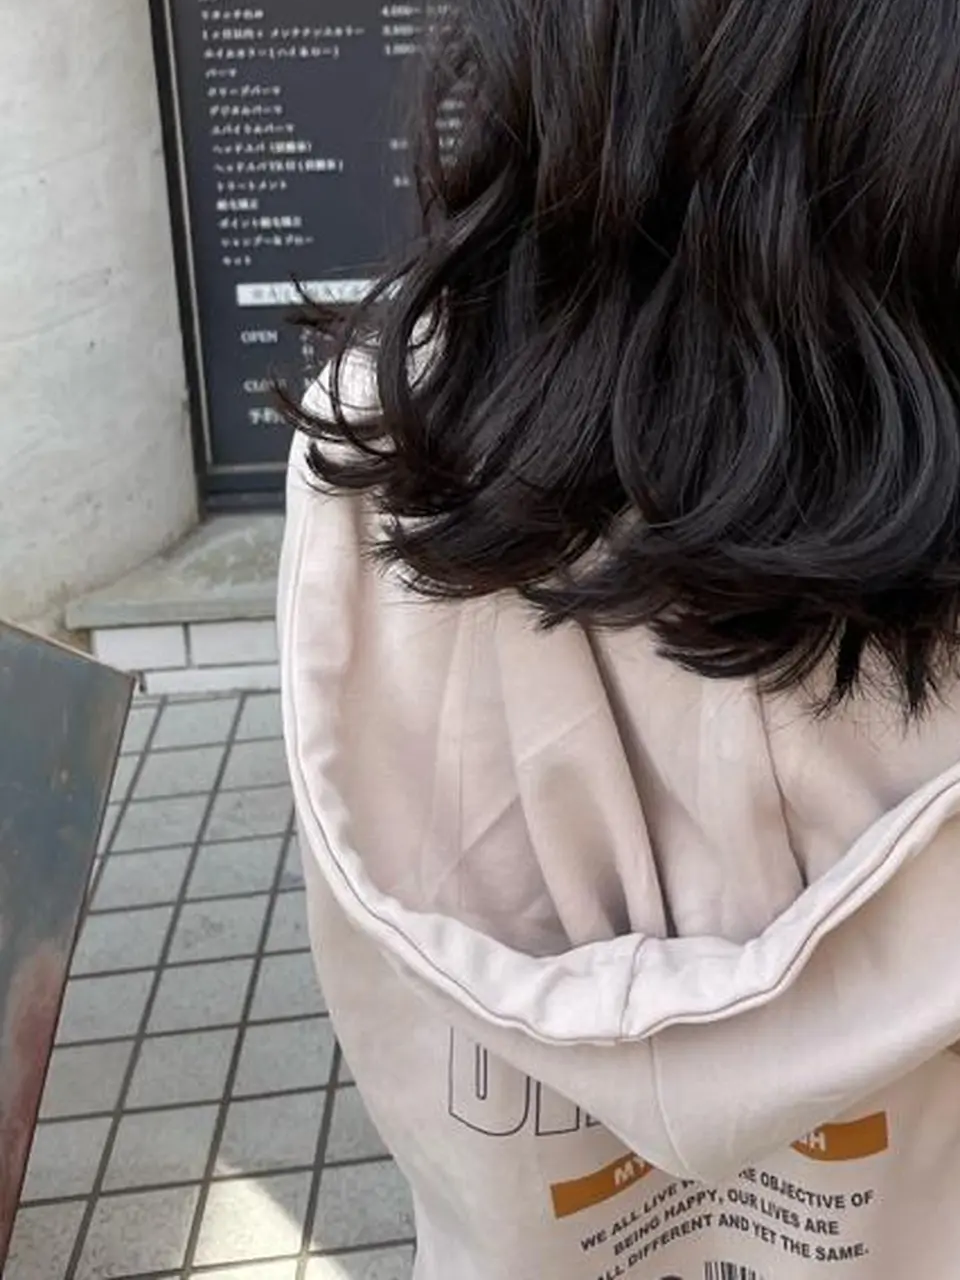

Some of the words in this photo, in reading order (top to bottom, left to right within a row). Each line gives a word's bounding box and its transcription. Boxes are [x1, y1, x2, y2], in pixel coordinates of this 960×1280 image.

[240, 330, 278, 343] OPEN
[580, 1229, 608, 1251] WE
[611, 1211, 640, 1236] ALL
[643, 1182, 678, 1214] LIVE
[760, 1171, 847, 1209] OBJECTIVE
[850, 1189, 875, 1208] OF
[613, 1215, 661, 1256] BEING
[727, 1188, 759, 1210] OUR
[760, 1198, 801, 1229] LIVES
[803, 1218, 840, 1236] ARE
[627, 1213, 713, 1268] DIFFERENT
[718, 1213, 750, 1232] AND
[752, 1221, 778, 1245] YET
[780, 1234, 812, 1259] THE
[814, 1242, 870, 1263] SAME.
